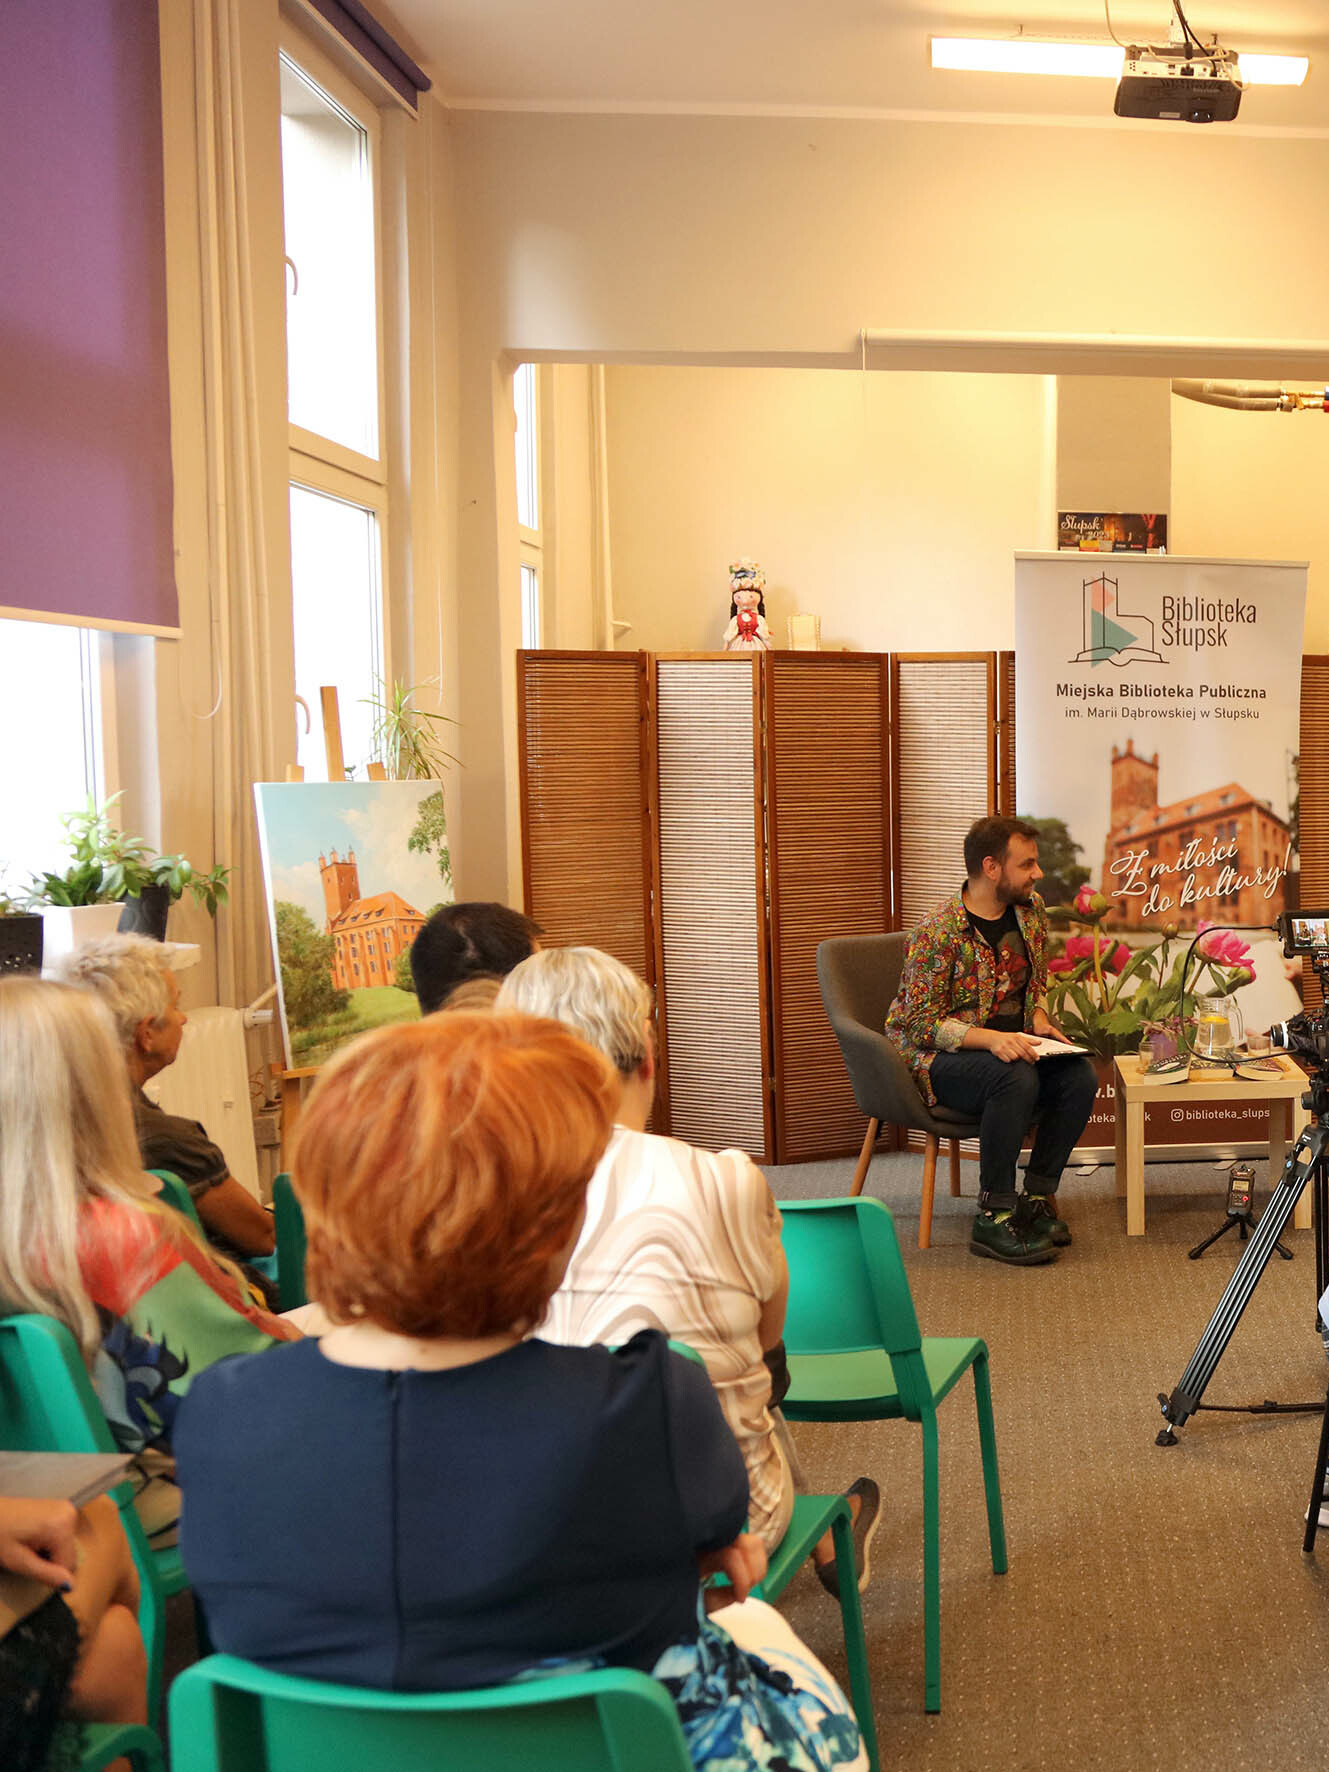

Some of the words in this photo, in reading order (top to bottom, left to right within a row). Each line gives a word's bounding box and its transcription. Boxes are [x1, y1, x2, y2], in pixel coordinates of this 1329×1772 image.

[1061, 514, 1100, 533] Słupsk
[1162, 595, 1257, 623] Biblioteka
[1161, 620, 1228, 652] Słupsk
[1056, 684, 1114, 700] Miejska
[1119, 684, 1194, 698] Biblioteka
[1199, 684, 1267, 699] Publiczna
[1065, 706, 1084, 718] im.
[1087, 707, 1118, 718] Marii
[1121, 707, 1196, 721] Dąbrowskiej
[1200, 709, 1211, 718] w
[1214, 707, 1260, 721] Słupsku
[1110, 850, 1149, 897] Z
[1150, 836, 1238, 878] miłości
[1141, 884, 1174, 917] do
[1180, 842, 1292, 908] kultury!
[1186, 1108, 1270, 1121] biblioteka_slups
